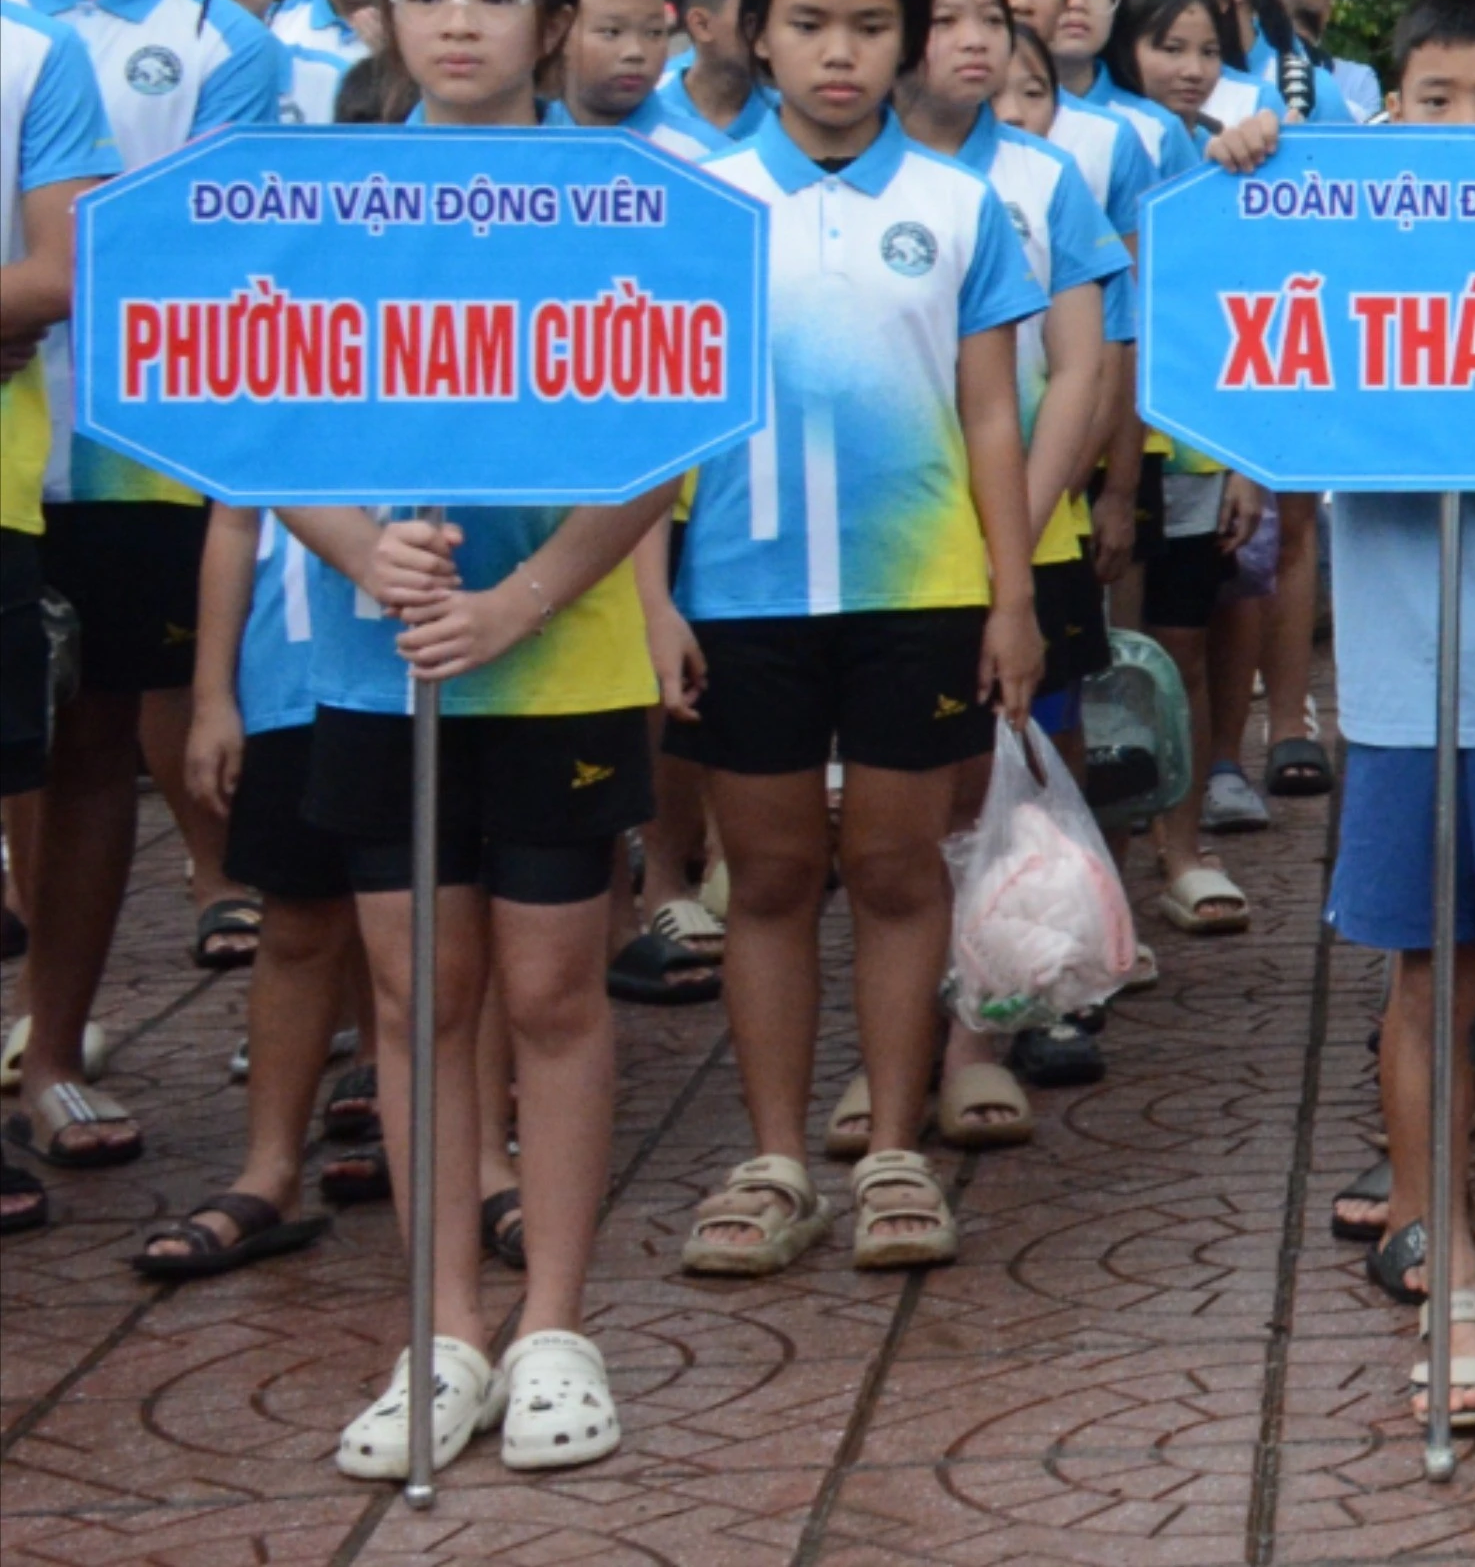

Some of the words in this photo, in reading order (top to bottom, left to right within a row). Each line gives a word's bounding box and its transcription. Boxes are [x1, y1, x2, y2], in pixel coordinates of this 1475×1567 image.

[192, 174, 318, 223] ĐOÀN
[335, 174, 422, 236] VẬN
[433, 176, 557, 237] ĐỘNG
[572, 176, 665, 226] VIÊN
[1239, 173, 1354, 221] ĐOÀN
[1366, 175, 1447, 231] VẬN
[123, 276, 365, 400] PHƯỜNG
[381, 301, 517, 400] NAM
[532, 278, 725, 400] CƯỜNG
[1219, 275, 1333, 390] XÃ
